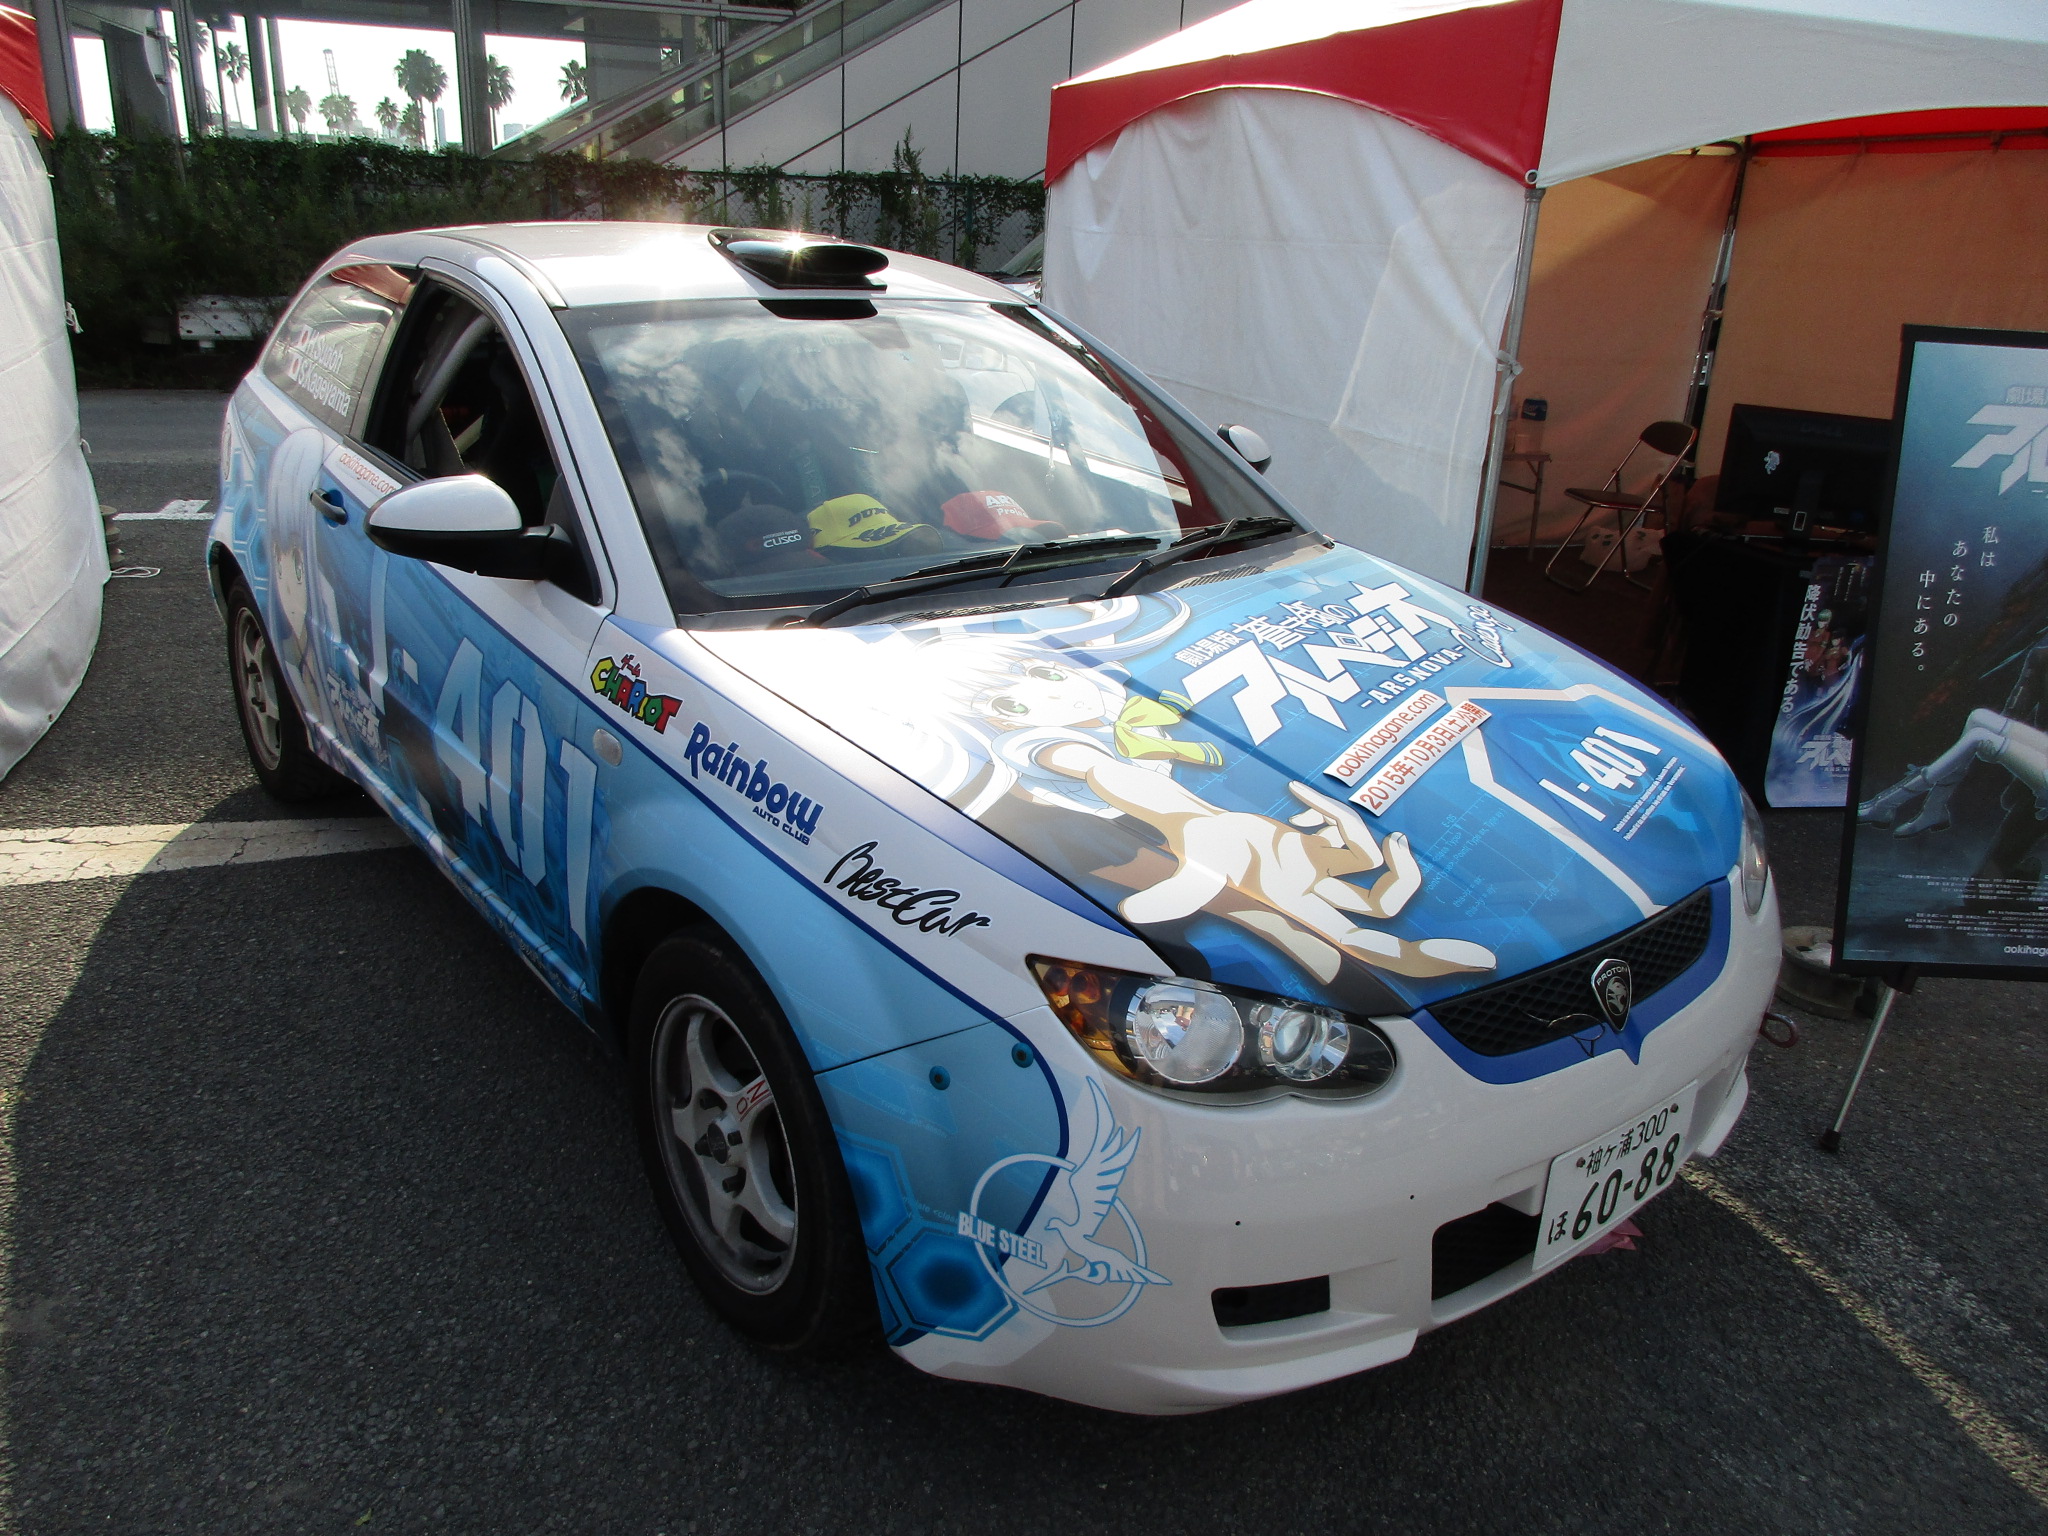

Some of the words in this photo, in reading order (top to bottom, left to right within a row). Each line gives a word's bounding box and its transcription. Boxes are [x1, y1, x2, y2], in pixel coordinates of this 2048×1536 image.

[763, 533, 802, 549] CUSCO
[1980, 526, 1999, 567] 私は
[1943, 540, 1968, 627] あなたの
[1174, 629, 1244, 667] 劇場版
[1779, 584, 1821, 718] 降伏勧告である。
[1911, 569, 1935, 671] 中にある。
[590, 656, 684, 735] CHARIOT
[620, 654, 642, 678] ゲーム
[1336, 693, 1438, 778] aokihagane.com
[683, 721, 825, 836] Rainbow
[752, 805, 780, 828] AUTO
[781, 822, 810, 846] CLUB
[1596, 965, 1628, 986] PROTON
[1548, 1211, 1568, 1245] ほ
[1572, 1133, 1680, 1240] 60-88
[957, 1211, 995, 1248] BLUE
[1000, 1228, 1048, 1269] STEEL
